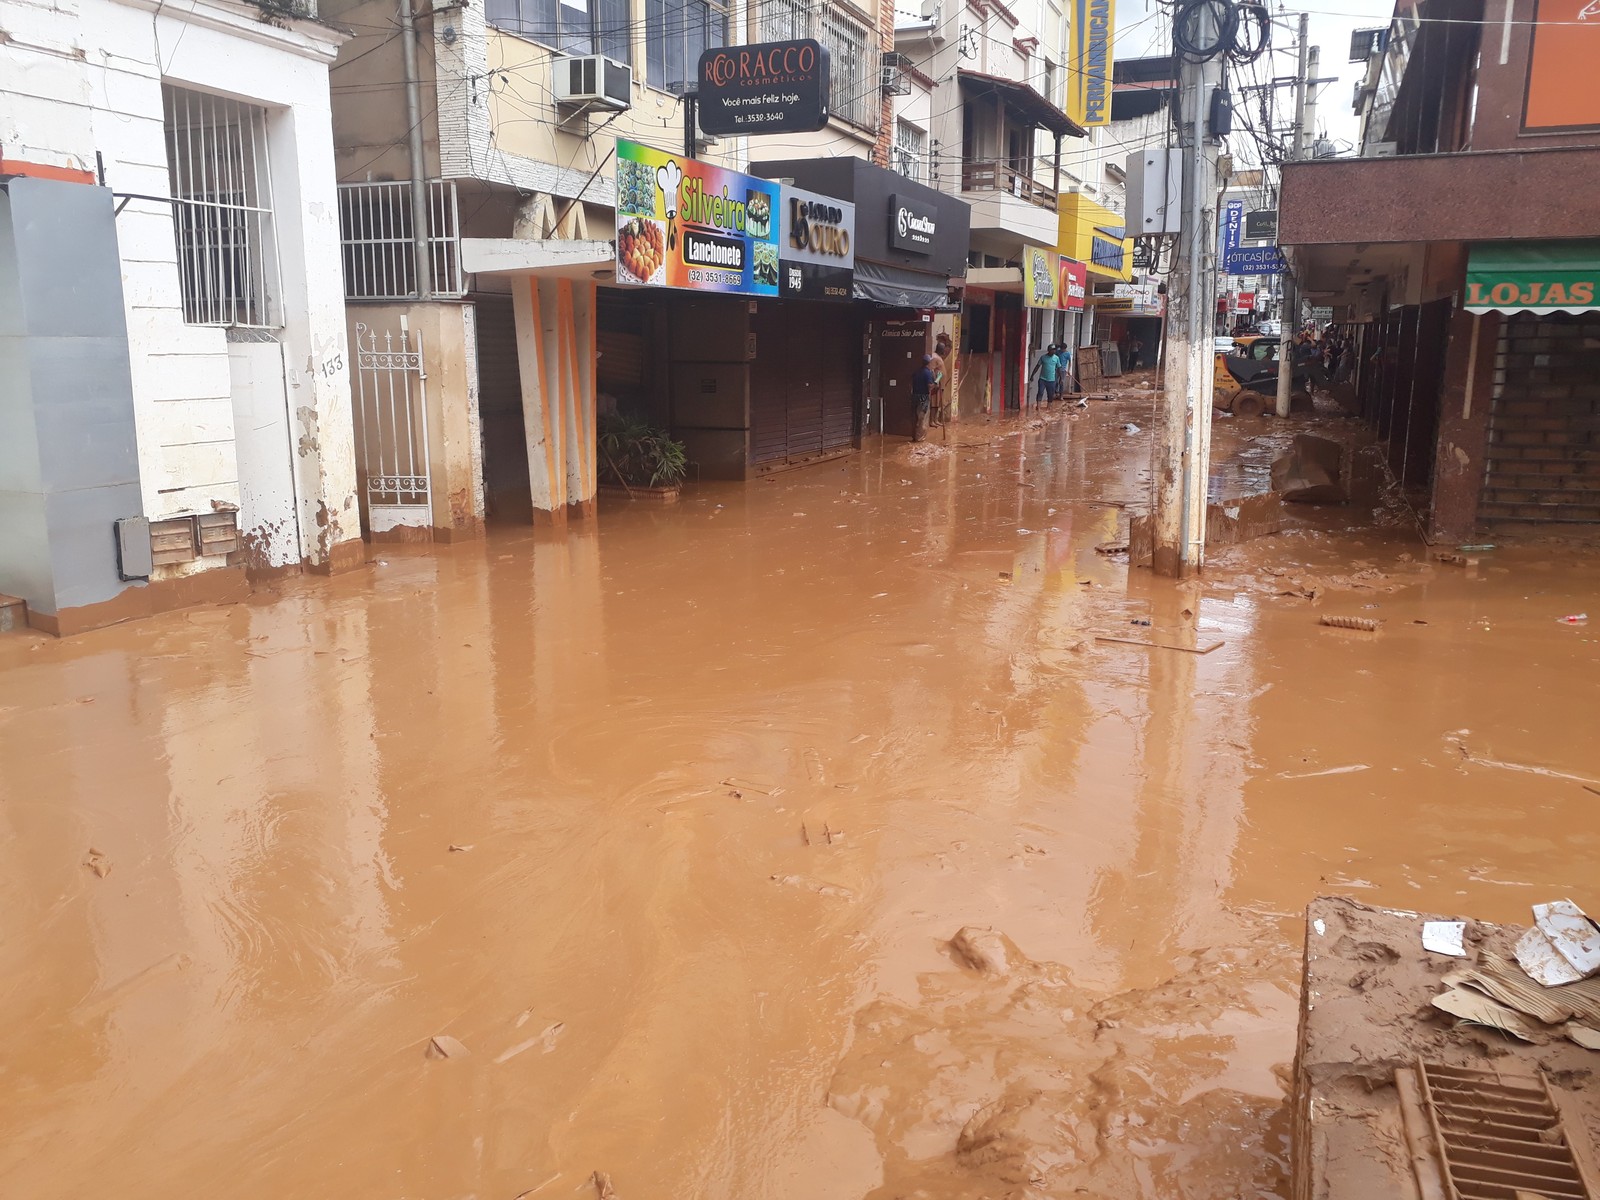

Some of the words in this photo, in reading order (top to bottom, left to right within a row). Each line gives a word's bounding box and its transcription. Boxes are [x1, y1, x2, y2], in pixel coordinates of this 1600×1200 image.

[740, 46, 814, 78] RACCO
[740, 75, 813, 86] cosméticos
[722, 97, 741, 107] Você
[742, 96, 761, 105] mais
[781, 92, 801, 105] hoje.
[681, 175, 746, 231] Silveira
[809, 222, 850, 257] OURO
[688, 237, 741, 267] Lanchonete
[1231, 252, 1262, 263] ÓTICAS
[688, 269, 703, 284] (32)
[788, 276, 802, 289] 1945
[1466, 282, 1594, 305] LOJAS
[322, 353, 343, 379] 133
